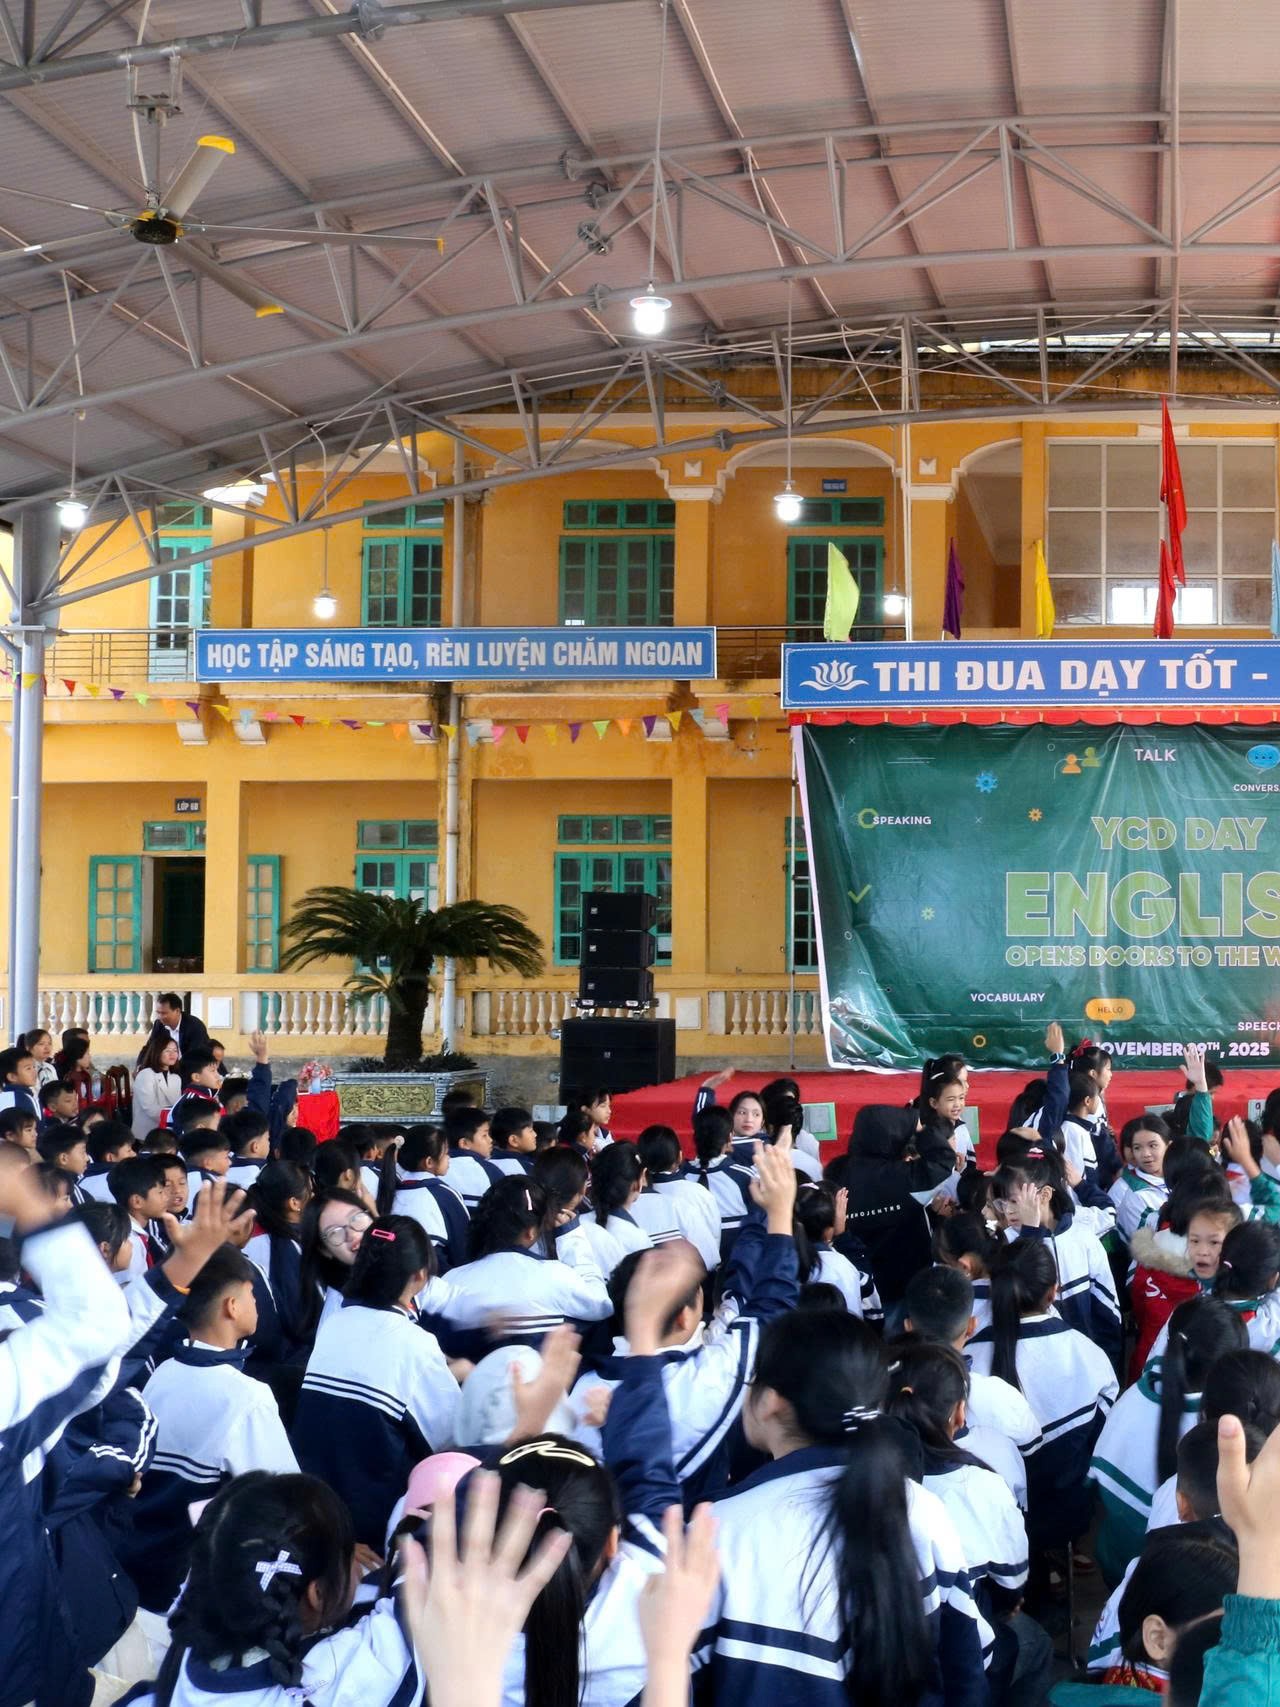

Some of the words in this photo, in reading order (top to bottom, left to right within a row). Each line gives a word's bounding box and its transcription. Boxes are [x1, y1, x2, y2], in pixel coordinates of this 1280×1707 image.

[207, 643, 250, 673] HỌC
[257, 639, 298, 673] TẬP
[305, 638, 365, 668] SÁNG
[371, 643, 419, 672] TẠO,
[426, 638, 470, 667] RÈN
[477, 637, 546, 671] LUYỆN
[553, 636, 617, 666] CHĂM
[625, 641, 702, 666] NGOAN
[873, 661, 940, 691] THI
[955, 660, 1045, 691] ĐUA
[1060, 659, 1145, 696] DẠY
[1159, 649, 1237, 689] TỐT
[1134, 749, 1176, 762] TALK
[873, 816, 932, 825] SPEAKING
[1091, 817, 1178, 850] YCD
[1185, 817, 1267, 850] DAY
[1005, 945, 1086, 967] OPENS
[1089, 945, 1176, 967] DOORS
[1177, 945, 1213, 967] TO
[1214, 945, 1260, 967] THE
[971, 993, 1045, 1002] VOCABULARY
[1097, 1006, 1124, 1014] HELLO
[1095, 1041, 1184, 1056] OVEMBER
[1229, 1042, 1270, 1056] 2025
